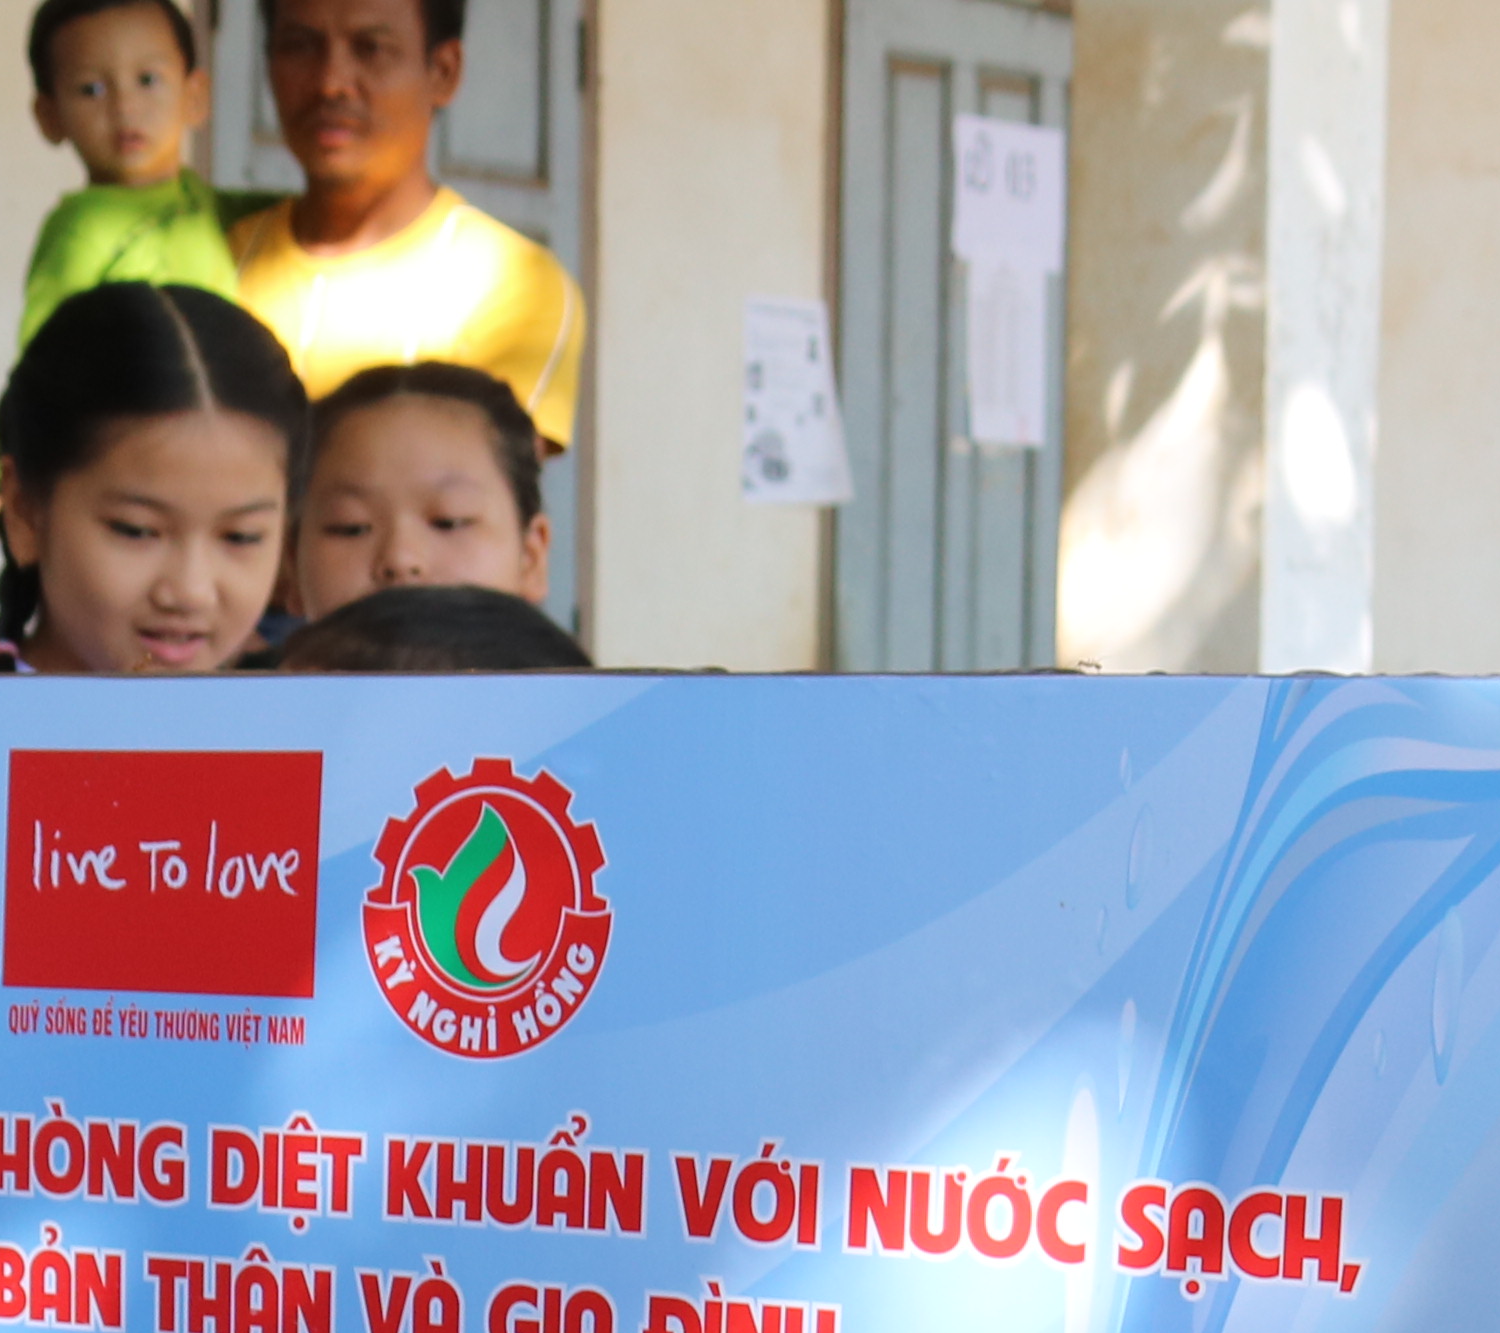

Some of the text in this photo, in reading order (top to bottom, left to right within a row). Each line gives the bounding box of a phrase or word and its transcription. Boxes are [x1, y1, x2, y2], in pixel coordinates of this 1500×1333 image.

[32, 822, 300, 900] live To love
[9, 1004, 307, 1045] QUỸ SỐNG ĐỂ YÊU THƯƠNG VIỆT NAM
[374, 935, 595, 1051] KỲ NGHỈ HỒNG
[211, 1115, 365, 1230] DIỆT
[386, 1119, 646, 1234] KHUẨN
[675, 1142, 821, 1246] VỚI
[847, 1156, 1090, 1266] NƯỚC
[1117, 1182, 1363, 1296] SẠCH,
